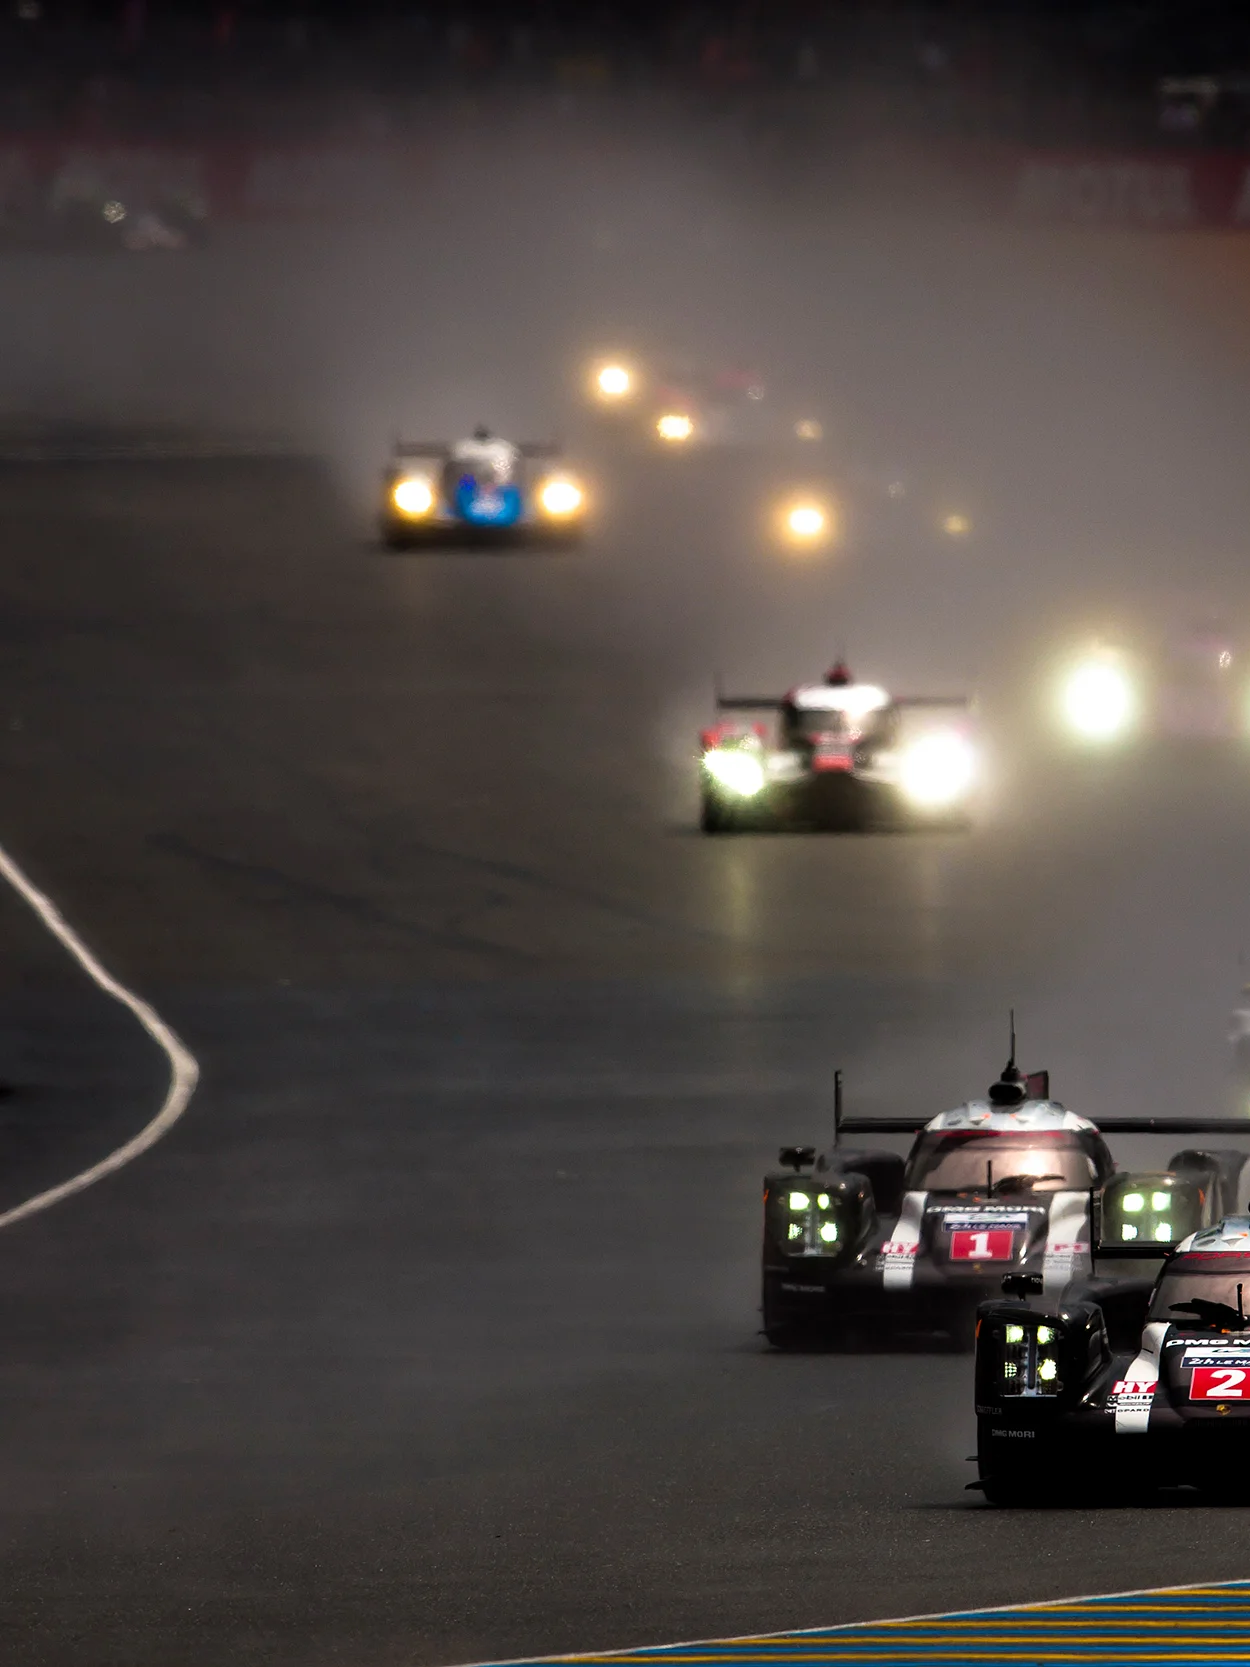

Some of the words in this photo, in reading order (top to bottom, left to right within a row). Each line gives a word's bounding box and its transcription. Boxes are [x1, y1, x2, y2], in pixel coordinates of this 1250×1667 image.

[968, 1232, 993, 1258] 1
[1166, 1339, 1229, 1348] DMG
[1113, 1381, 1156, 1393] HY
[1205, 1369, 1246, 1398] 2
[1008, 1430, 1036, 1438] MORI
